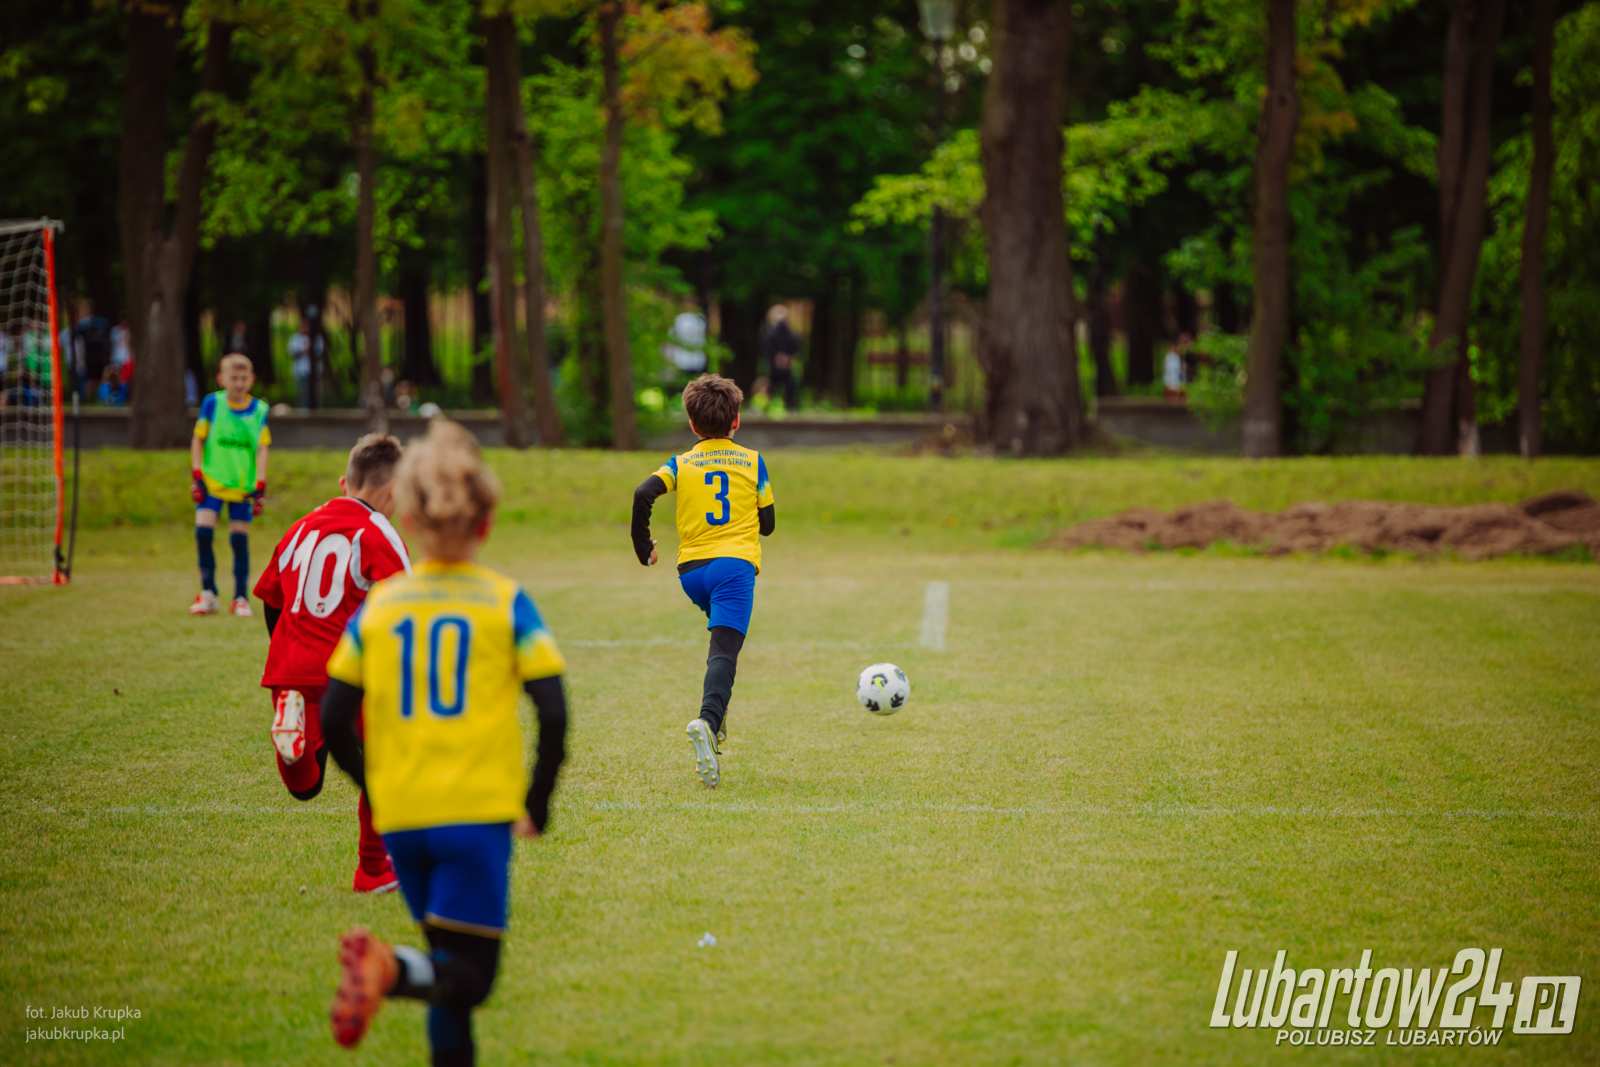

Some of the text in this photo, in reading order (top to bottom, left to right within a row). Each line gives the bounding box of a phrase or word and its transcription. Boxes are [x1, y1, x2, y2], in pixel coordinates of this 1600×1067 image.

[704, 470, 731, 526] 3
[291, 529, 351, 619] 10
[393, 615, 471, 718] 10
